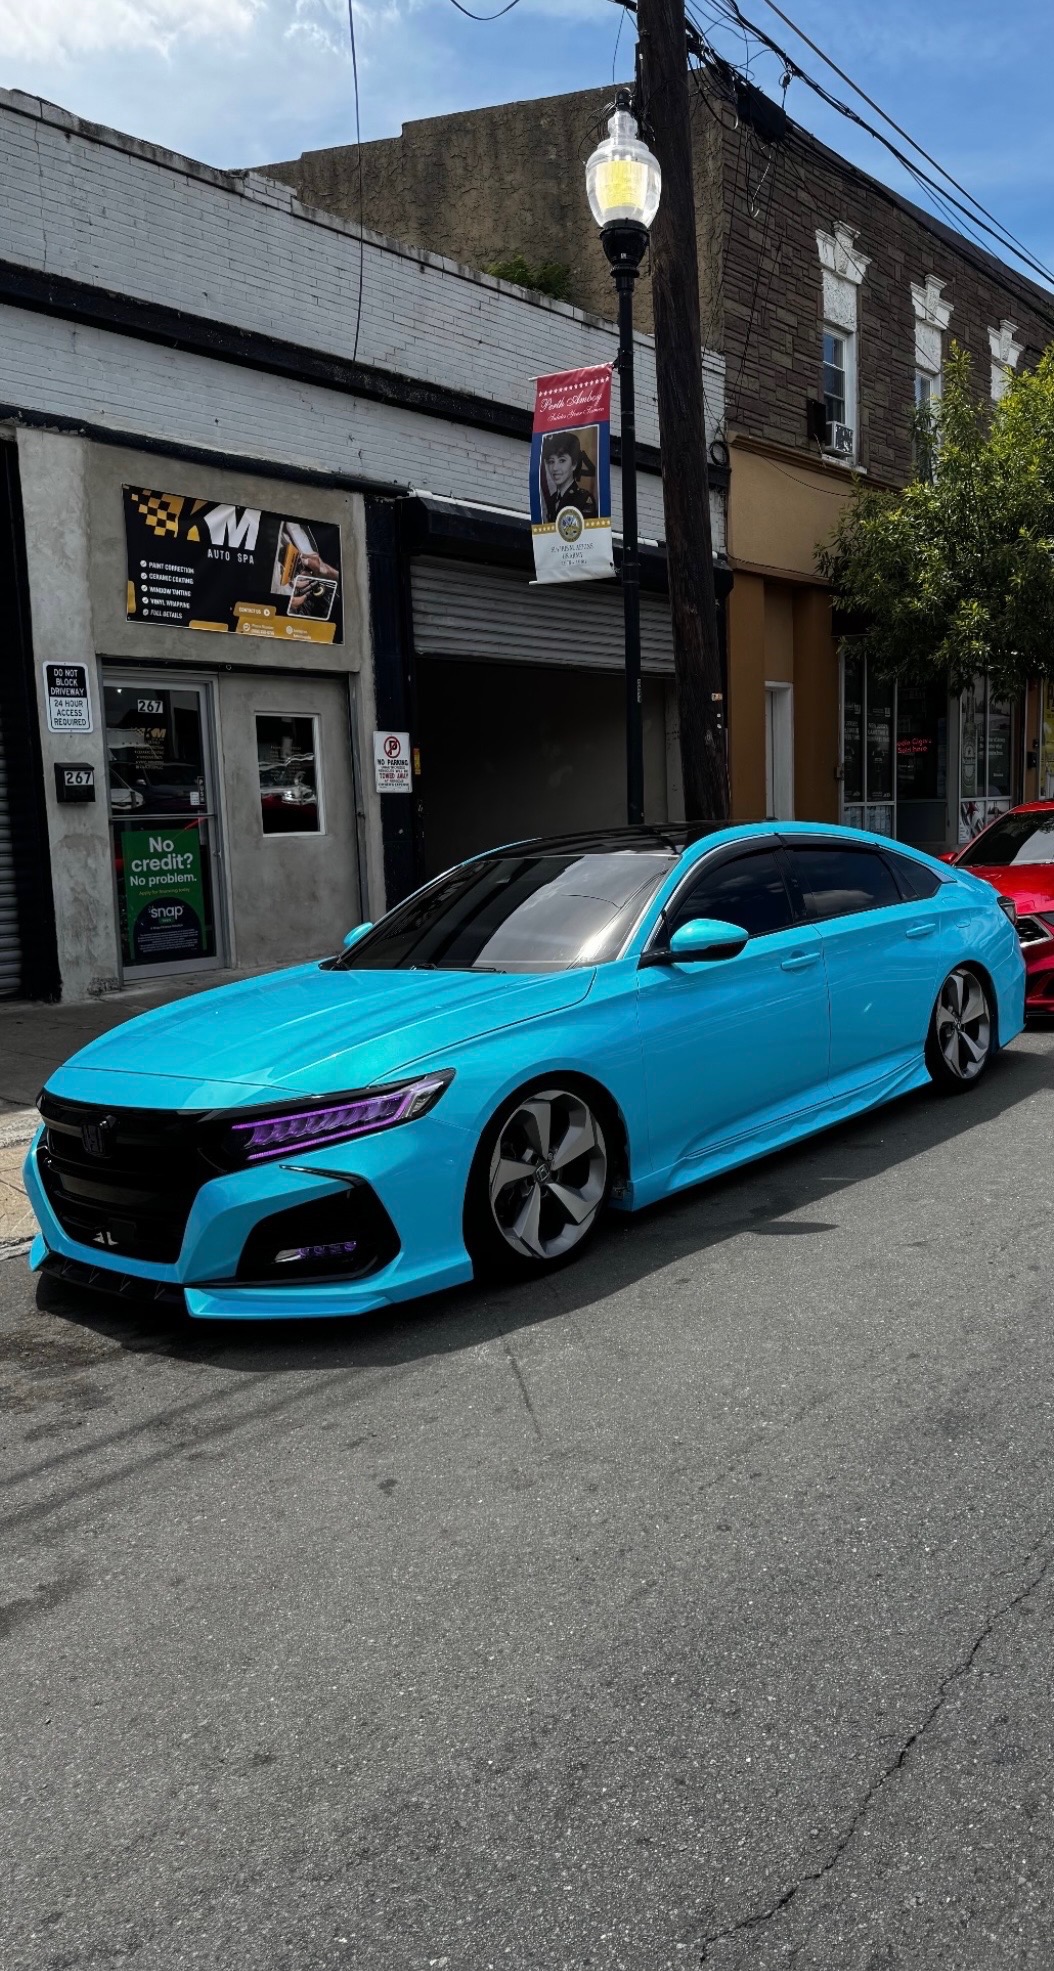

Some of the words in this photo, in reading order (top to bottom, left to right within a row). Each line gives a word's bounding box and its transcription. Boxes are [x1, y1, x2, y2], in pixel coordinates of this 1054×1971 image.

[540, 397, 565, 413] Perth
[566, 390, 603, 407] Amboy
[207, 548, 230, 561] AUTO
[237, 552, 254, 565] SPA
[148, 561, 164, 570] PAINT
[164, 563, 195, 574] CORRECTION
[148, 573, 172, 582] CERAMIC
[172, 576, 194, 585] COATING
[149, 586, 171, 595] WINDOW
[171, 588, 192, 597] TINTING
[149, 598, 165, 606] VINYL
[166, 600, 191, 610] WRAPPING
[162, 610, 183, 620] DETAILS
[53, 668, 63, 677] DO
[64, 669, 79, 678] NOT
[55, 678, 79, 687] BLOCK
[50, 686, 85, 696] DRIVEWAY
[54, 699, 63, 708] 24
[64, 700, 84, 708] HOUR
[138, 700, 162, 713] 267
[56, 709, 83, 717] ACCESS
[53, 717, 87, 726] REQUIRED
[66, 771, 91, 784] 267
[148, 836, 174, 853] No
[131, 852, 194, 873] credit?
[129, 876, 146, 887] No
[148, 872, 197, 888] problem.
[150, 905, 183, 921] snap
